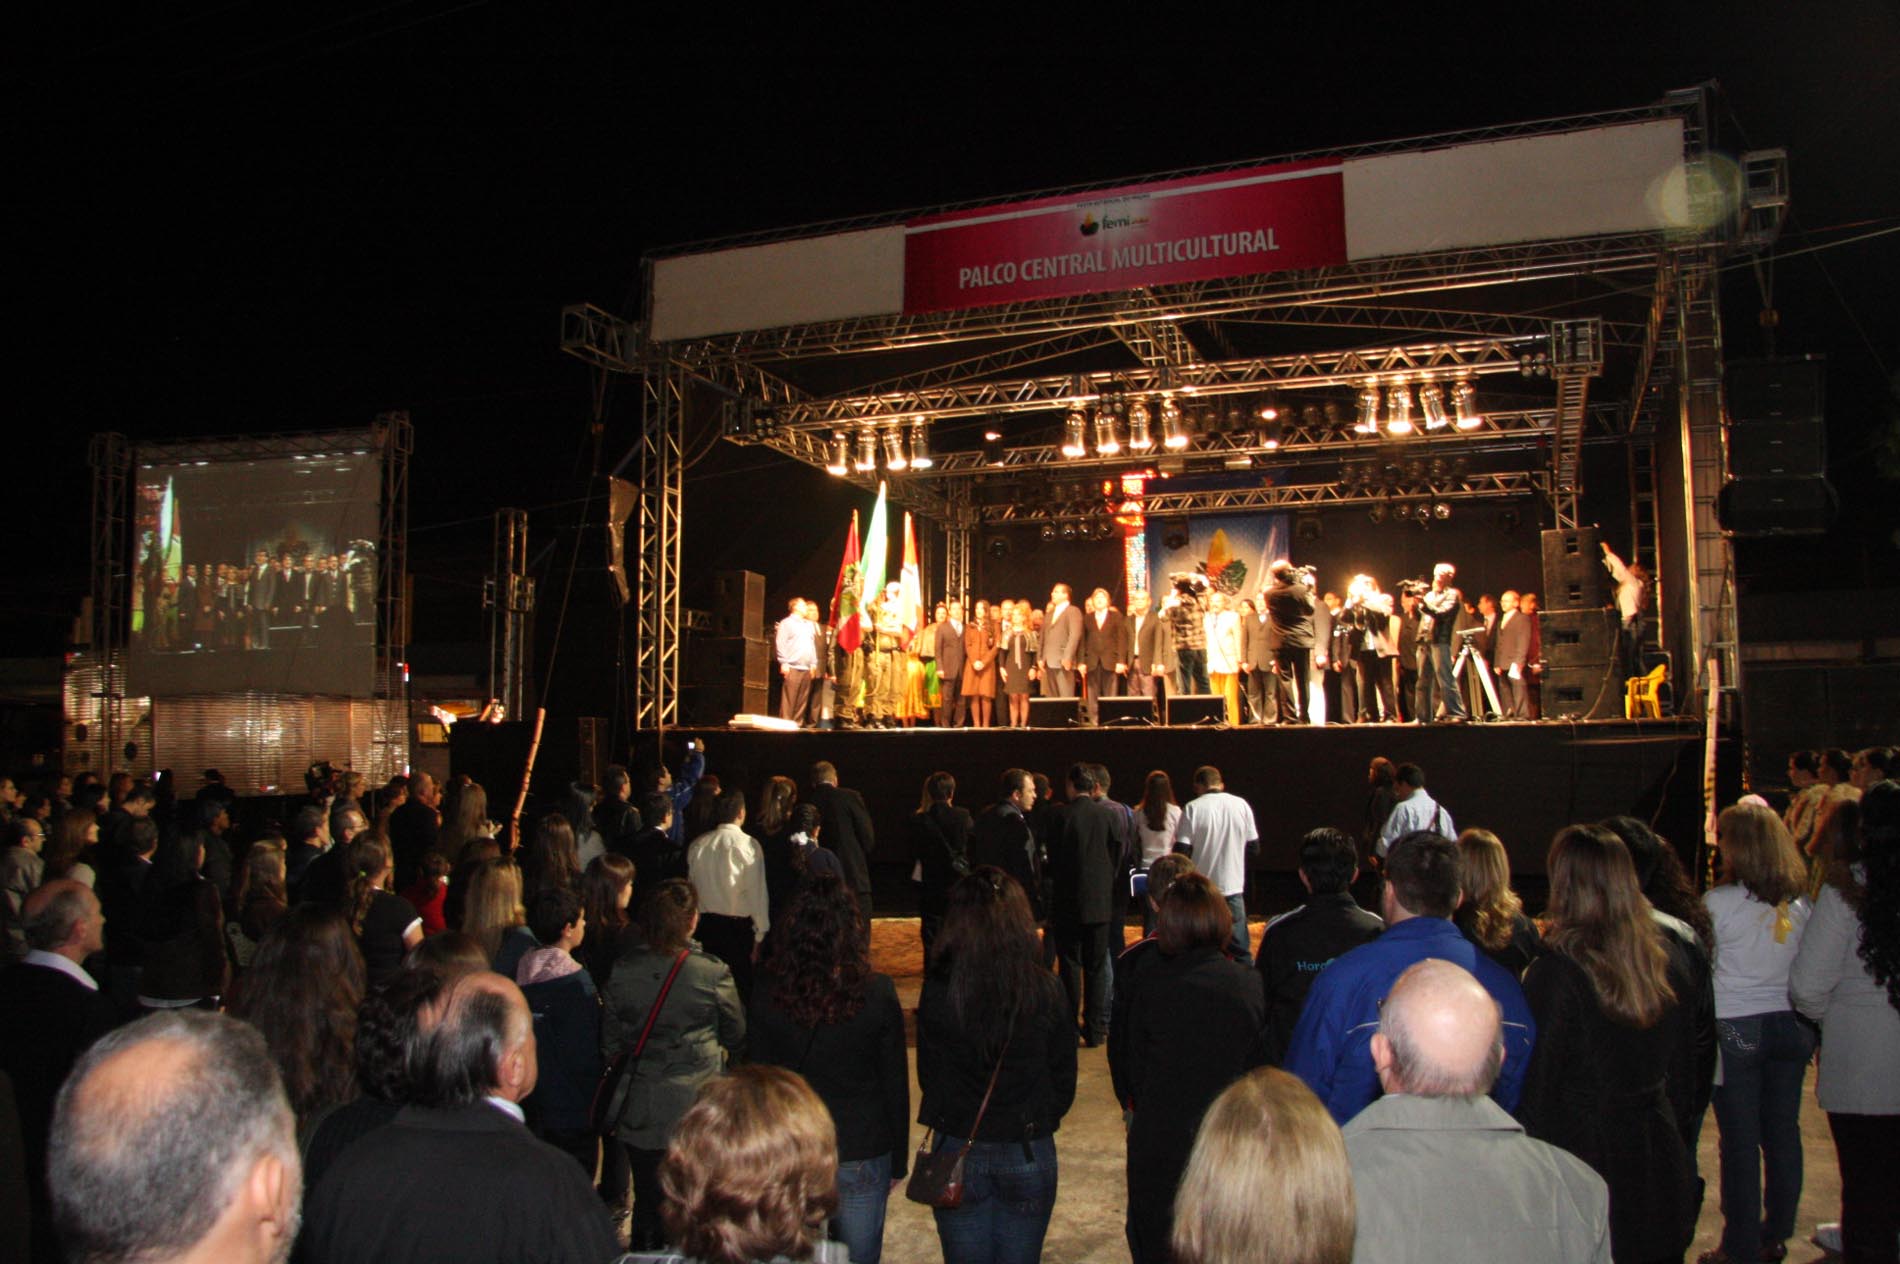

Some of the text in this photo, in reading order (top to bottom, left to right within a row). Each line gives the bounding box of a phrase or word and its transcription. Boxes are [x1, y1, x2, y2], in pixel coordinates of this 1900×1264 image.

[959, 227, 1280, 289] PALCO CENTRAL MULTICULTURAL
